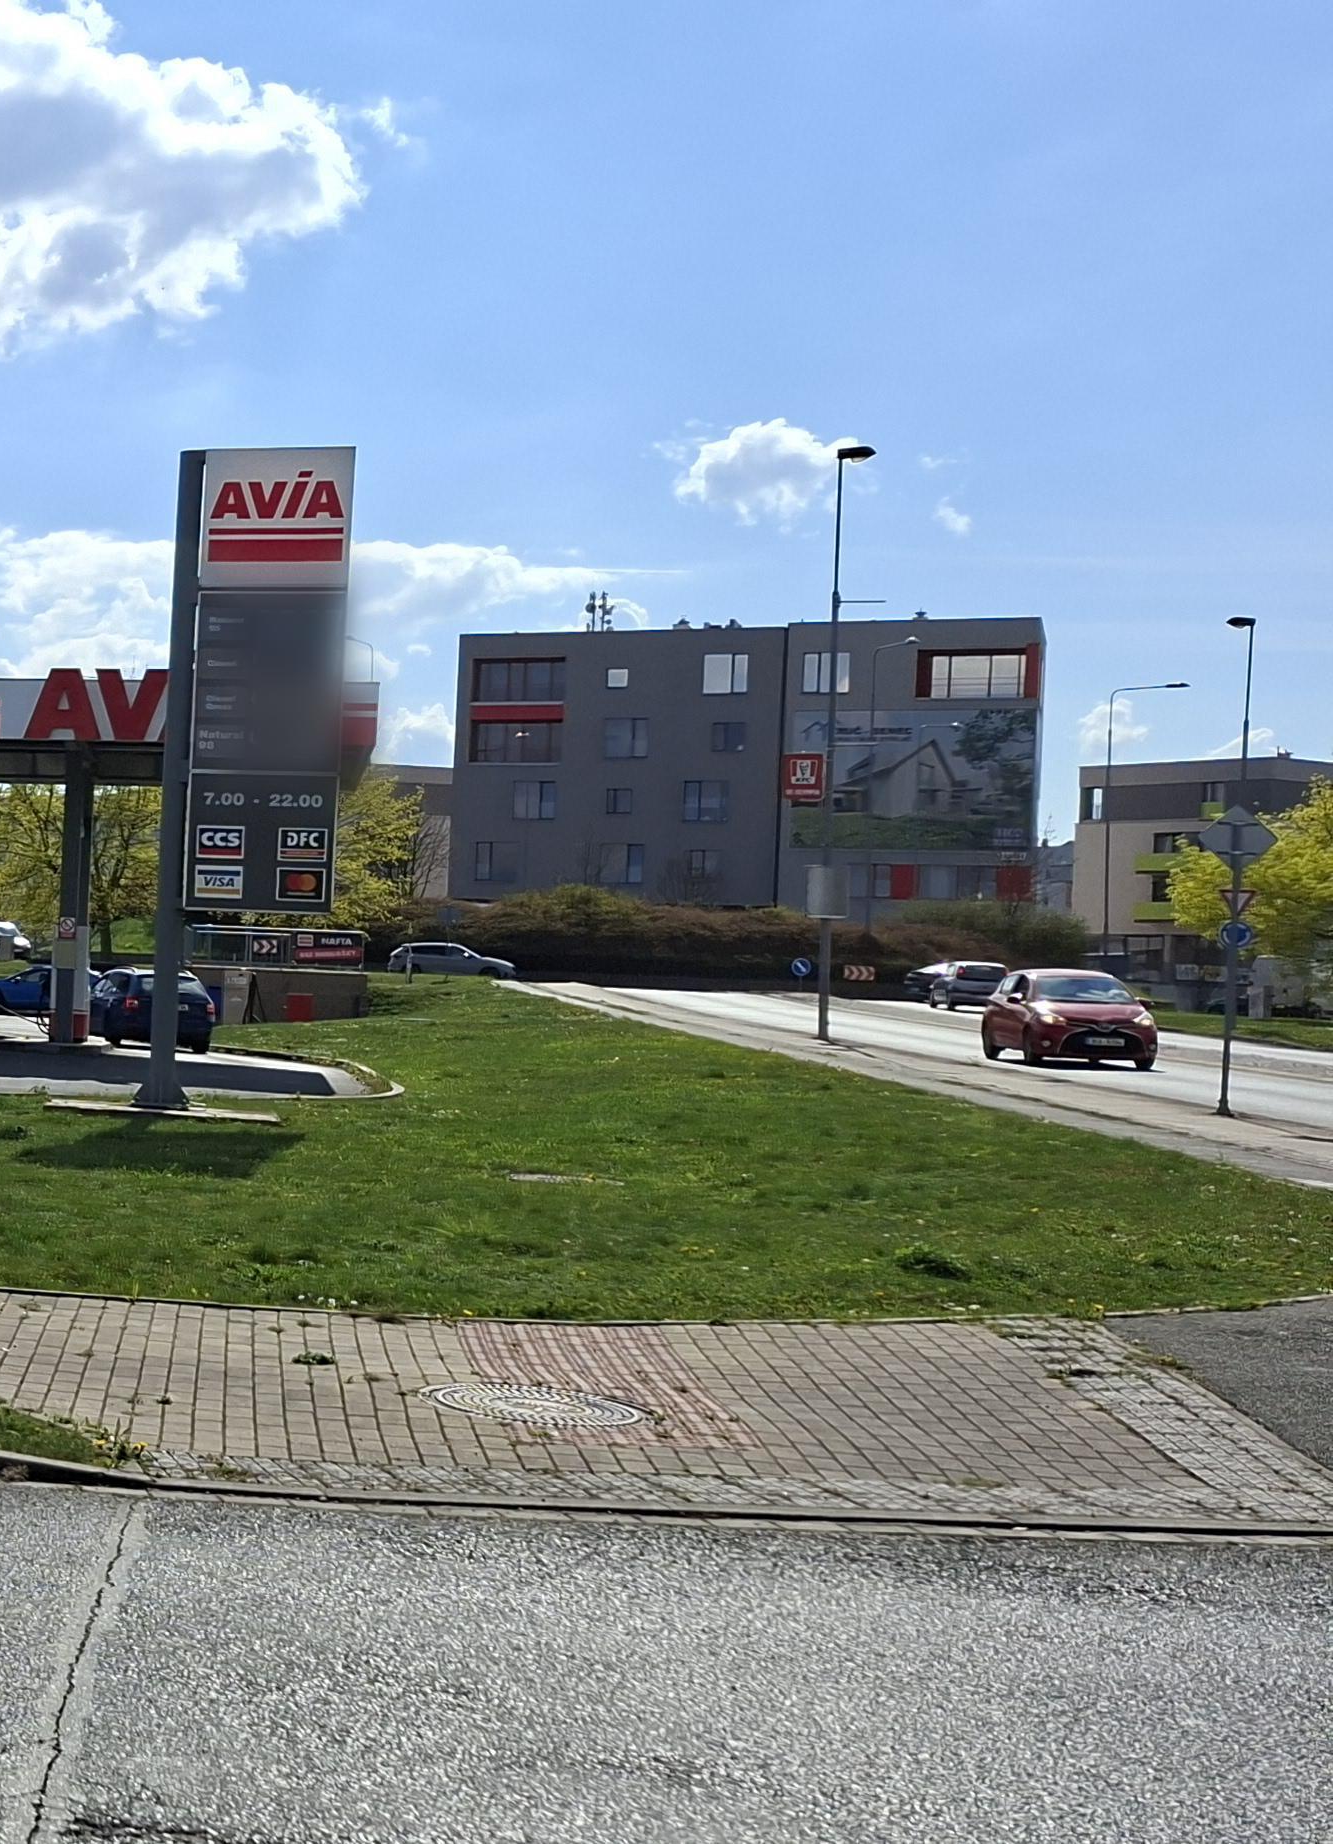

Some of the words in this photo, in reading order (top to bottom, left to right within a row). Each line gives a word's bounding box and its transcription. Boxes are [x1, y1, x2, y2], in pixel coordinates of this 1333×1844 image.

[23, 667, 170, 741] AV
[202, 792, 245, 806] 7.00
[268, 793, 323, 808] 22.00
[200, 831, 241, 848] CCS
[286, 832, 319, 848] DFC
[203, 876, 235, 888] VISA
[320, 937, 353, 946] NAFTA
